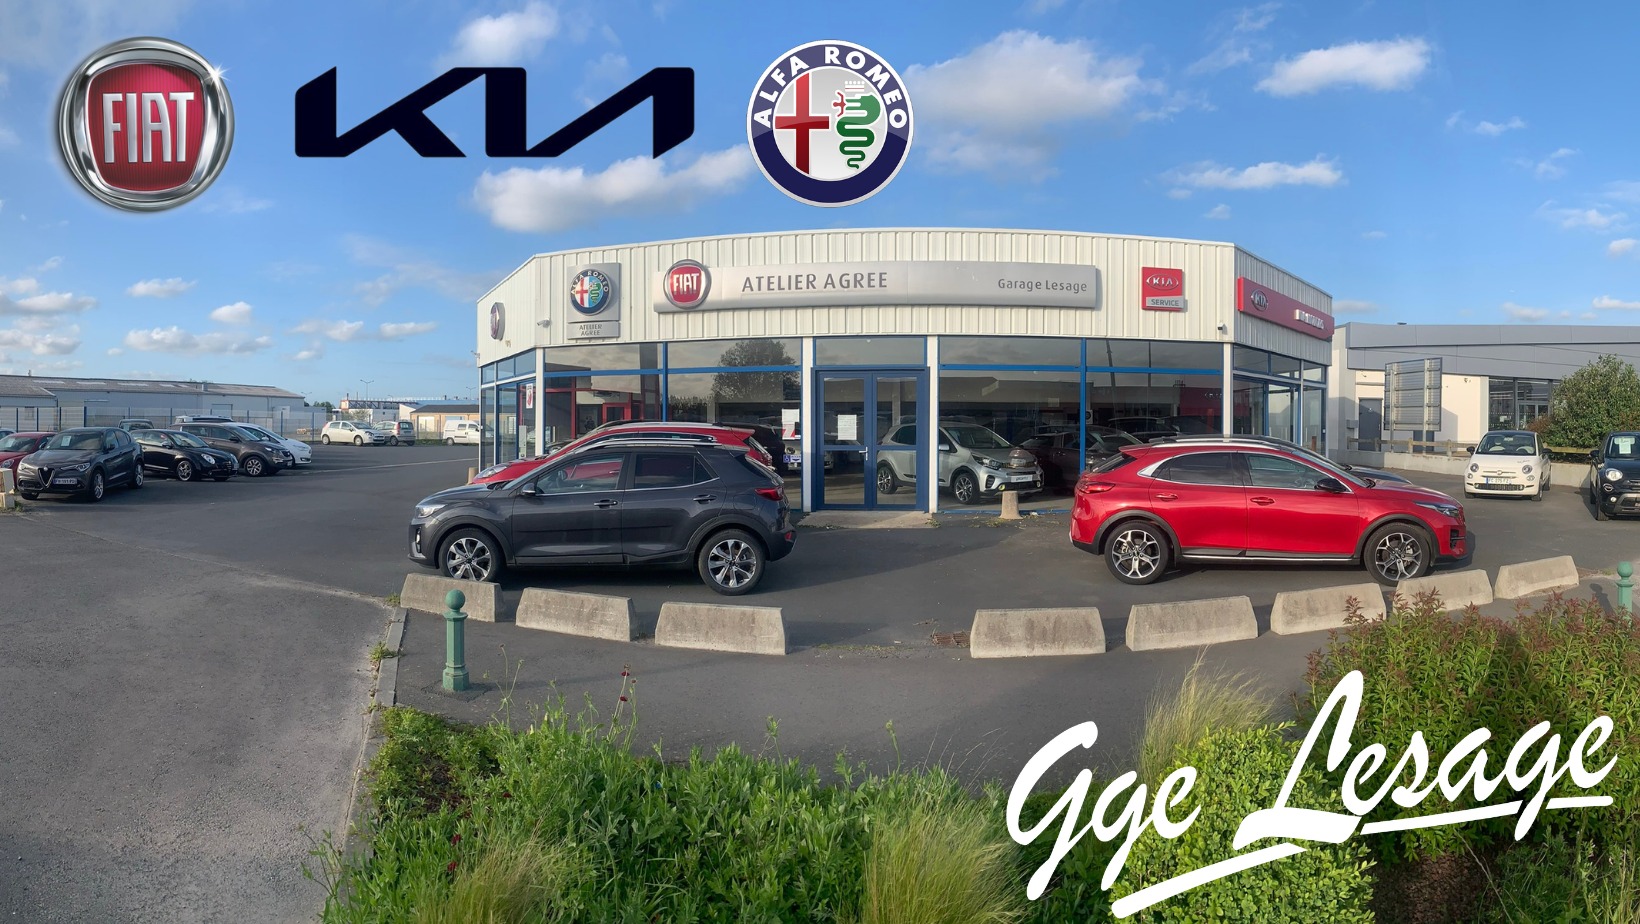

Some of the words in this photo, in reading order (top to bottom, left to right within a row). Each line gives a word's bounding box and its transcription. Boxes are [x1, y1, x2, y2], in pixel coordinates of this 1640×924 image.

[571, 274, 584, 294] ALFA
[587, 270, 609, 292] ROMEO
[672, 272, 700, 295] FIAT
[742, 273, 817, 292] ATELIER
[824, 272, 888, 289] AGREE
[998, 278, 1042, 292] Garage
[1045, 280, 1087, 294] Lesage
[1152, 276, 1173, 287] KIA
[1151, 298, 1180, 307] SERVICE
